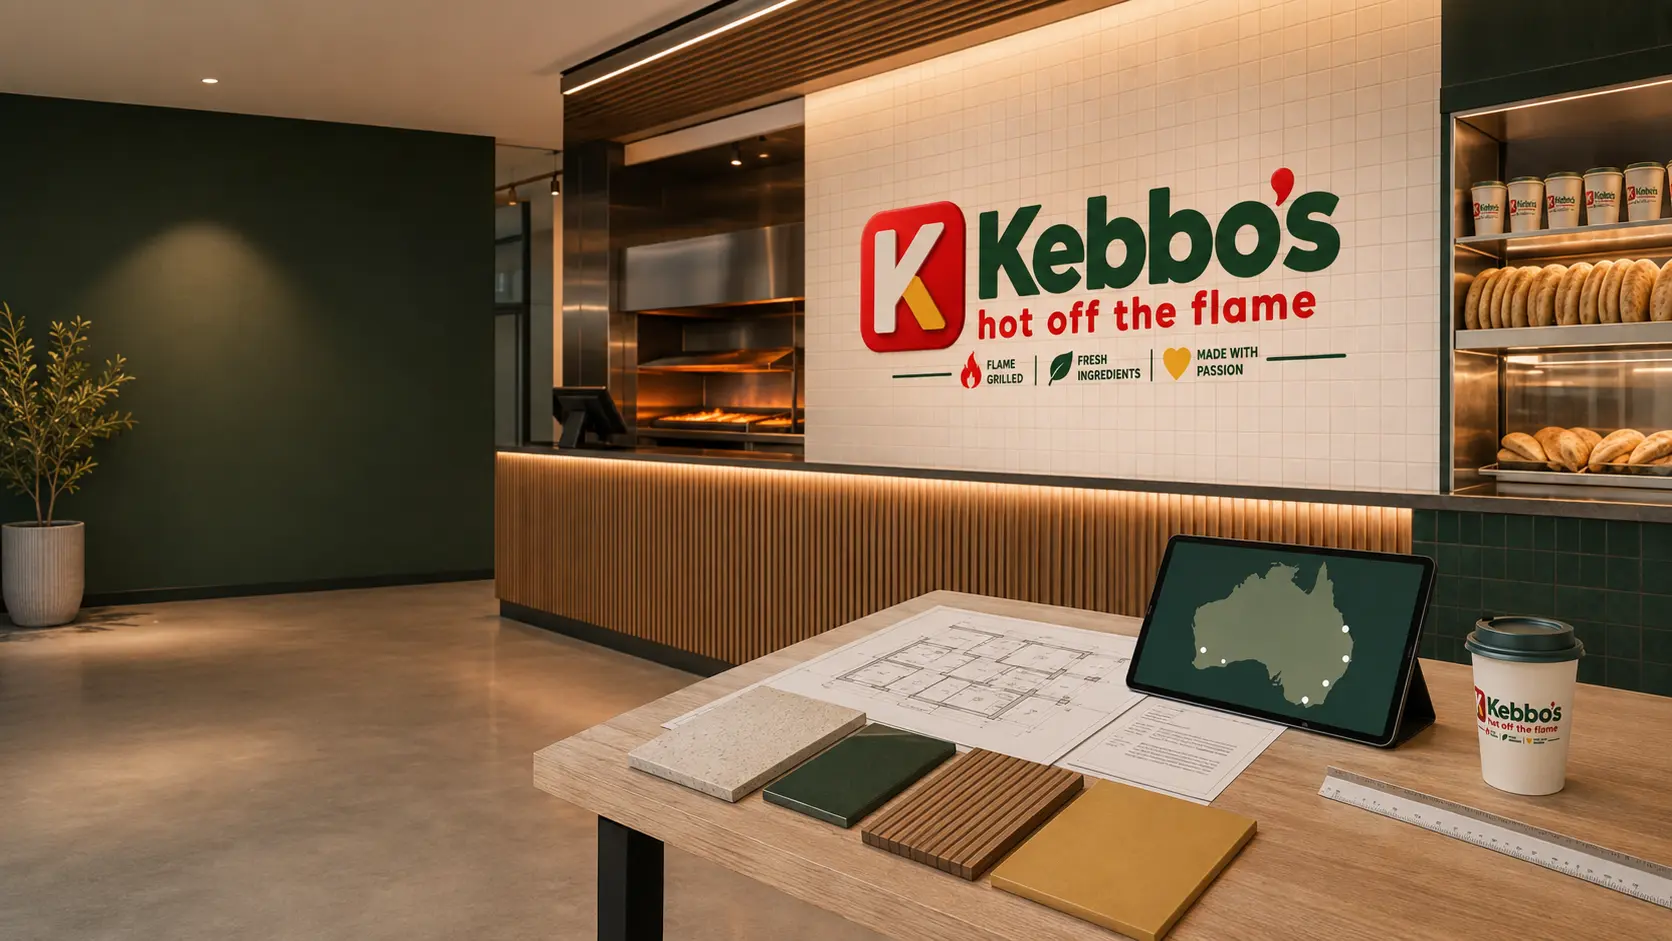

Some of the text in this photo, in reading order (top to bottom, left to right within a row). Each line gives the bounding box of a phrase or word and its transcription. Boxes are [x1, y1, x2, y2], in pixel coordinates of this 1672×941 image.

[978, 167, 1341, 300] Kebbo's
[873, 221, 946, 335] K
[978, 289, 1317, 340] hot off the flame
[1077, 354, 1108, 366] FRESH
[1197, 346, 1259, 361] MADE WITH
[986, 359, 1016, 371] FLAME
[1197, 363, 1244, 377] PASSION
[986, 374, 1024, 385] GRILLED
[1077, 368, 1141, 381] INGREDIENTS
[1487, 696, 1562, 723] Kebbo's
[1501, 722, 1514, 731] off
[1516, 724, 1532, 733] the
[1534, 725, 1558, 734] flame
